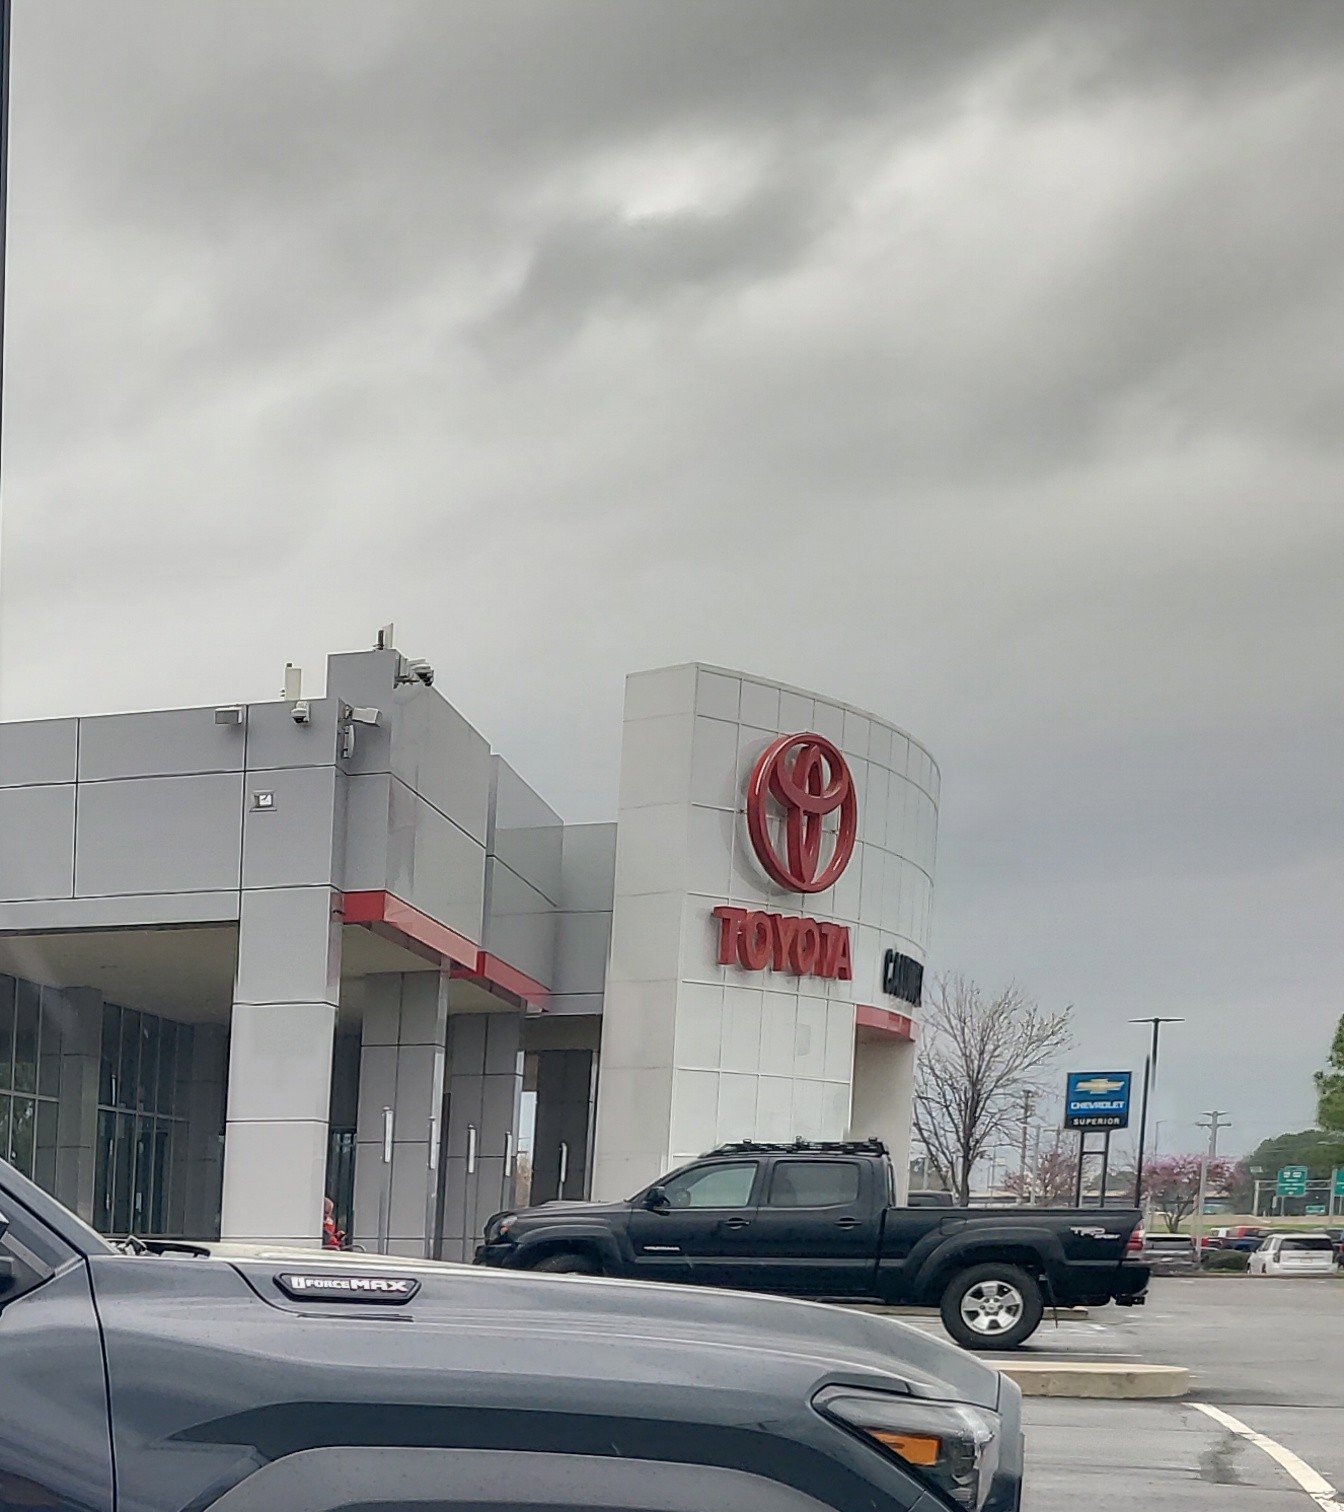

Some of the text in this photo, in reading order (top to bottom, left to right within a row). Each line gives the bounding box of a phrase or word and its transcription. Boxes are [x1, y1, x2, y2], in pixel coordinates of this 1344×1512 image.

[713, 906, 852, 981] TOYOTA
[1071, 1101, 1125, 1109] CHEVROLET
[1073, 1117, 1120, 1125] SUPERIOR
